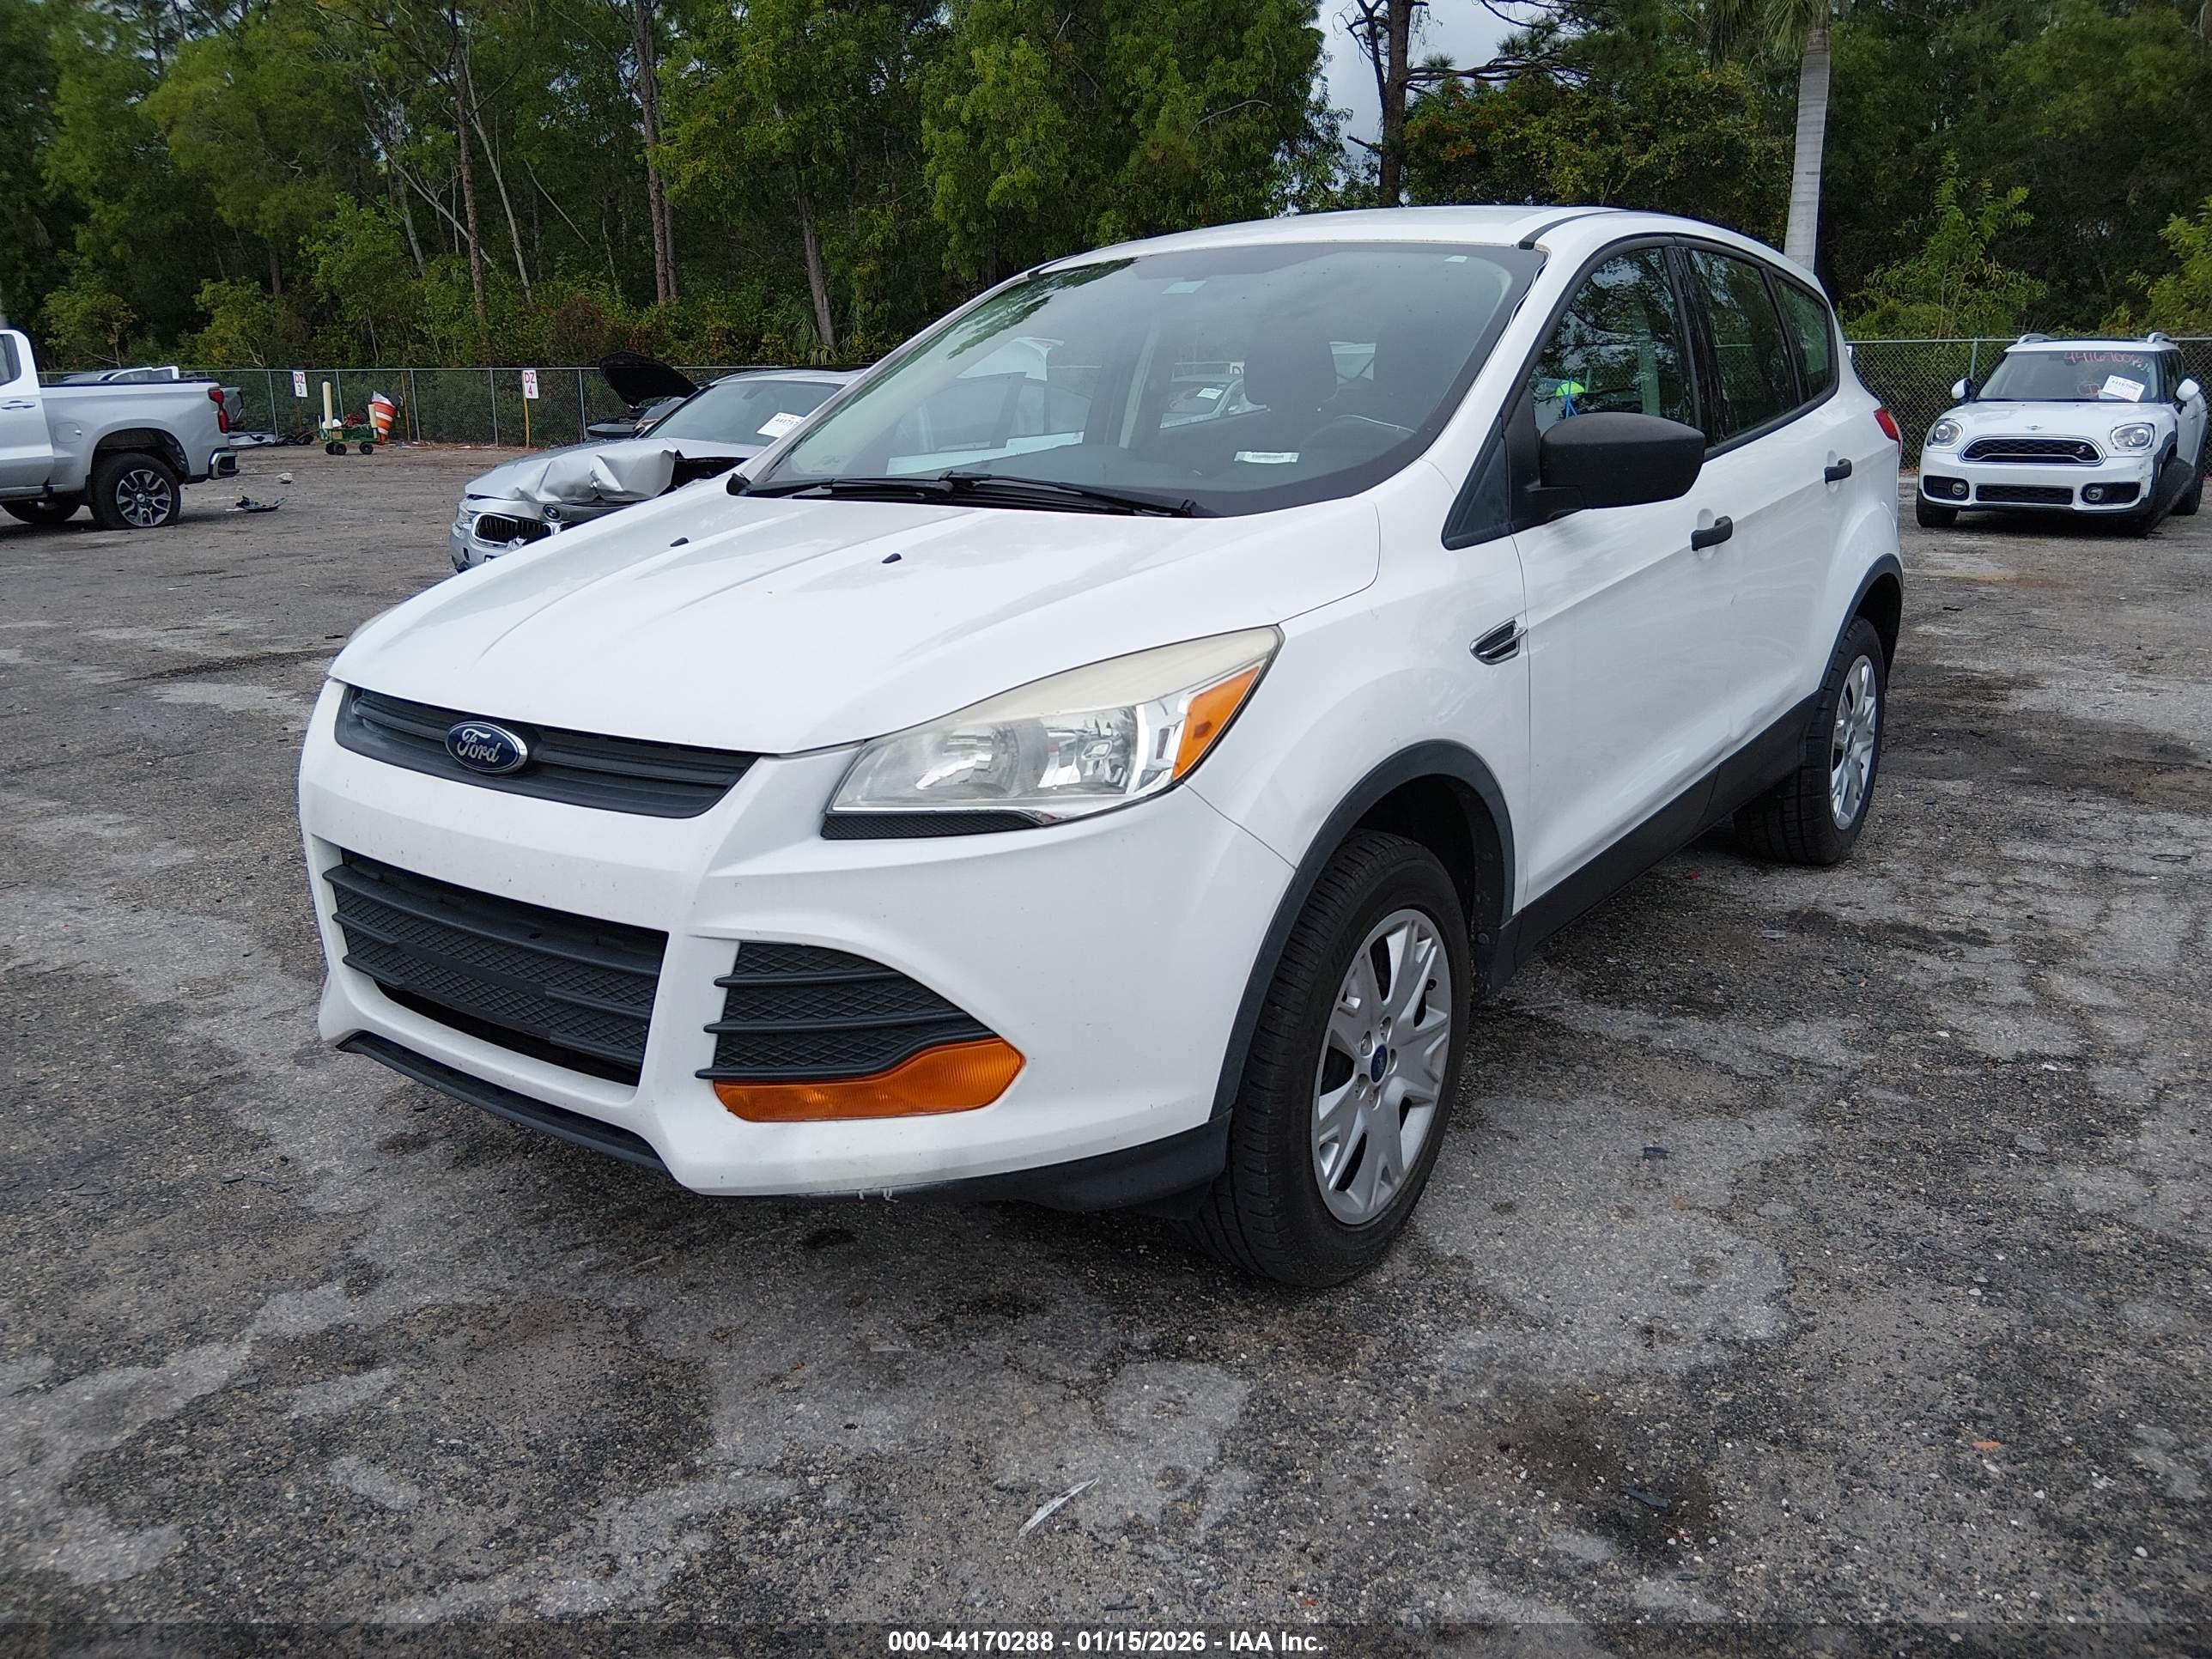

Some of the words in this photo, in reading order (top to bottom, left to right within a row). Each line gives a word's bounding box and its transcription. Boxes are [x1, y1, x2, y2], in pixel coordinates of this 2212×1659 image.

[295, 374, 305, 384] DZ
[525, 372, 536, 384] DZ
[528, 385, 533, 396] 4
[457, 728, 502, 763] Ford
